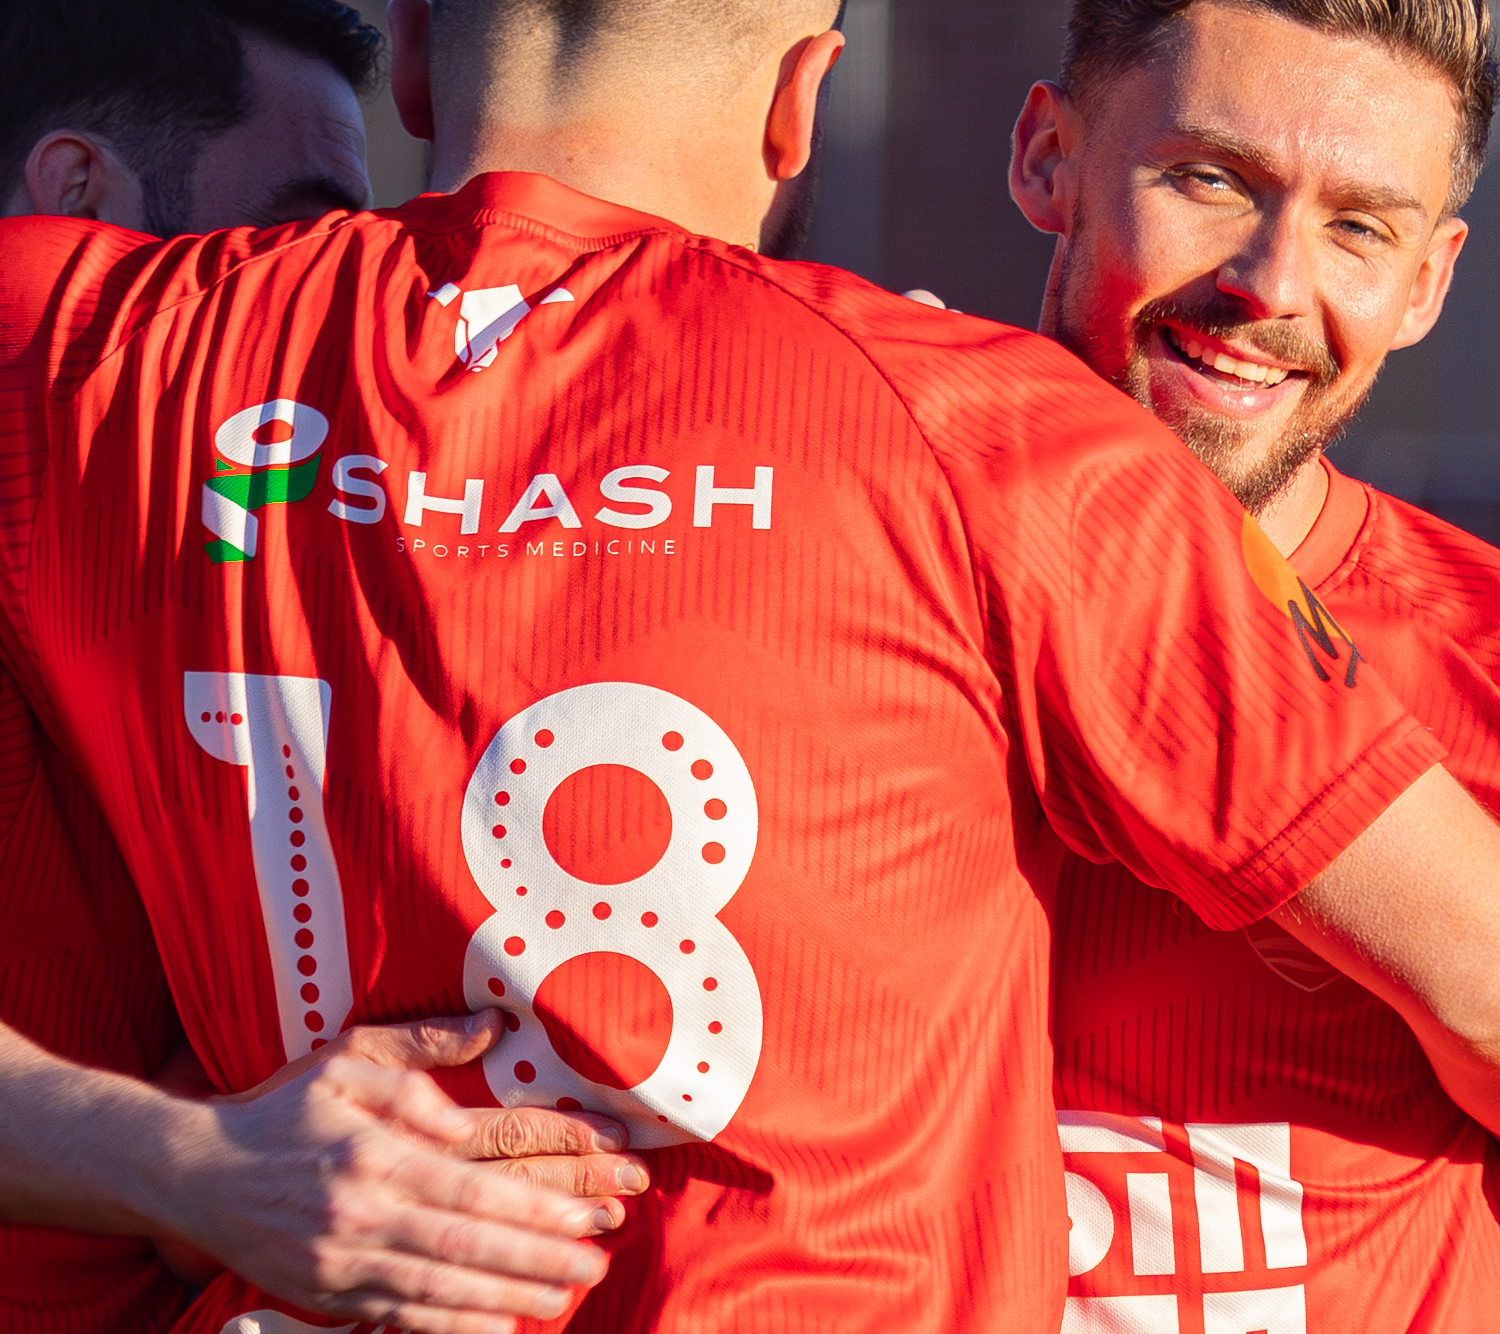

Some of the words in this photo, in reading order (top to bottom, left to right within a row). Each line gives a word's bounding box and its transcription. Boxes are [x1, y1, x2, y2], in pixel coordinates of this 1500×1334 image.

[327, 454, 774, 535] SHASH
[396, 536, 509, 558] SPORTS
[525, 539, 676, 558] MEDICINE
[184, 670, 764, 1149] 18
